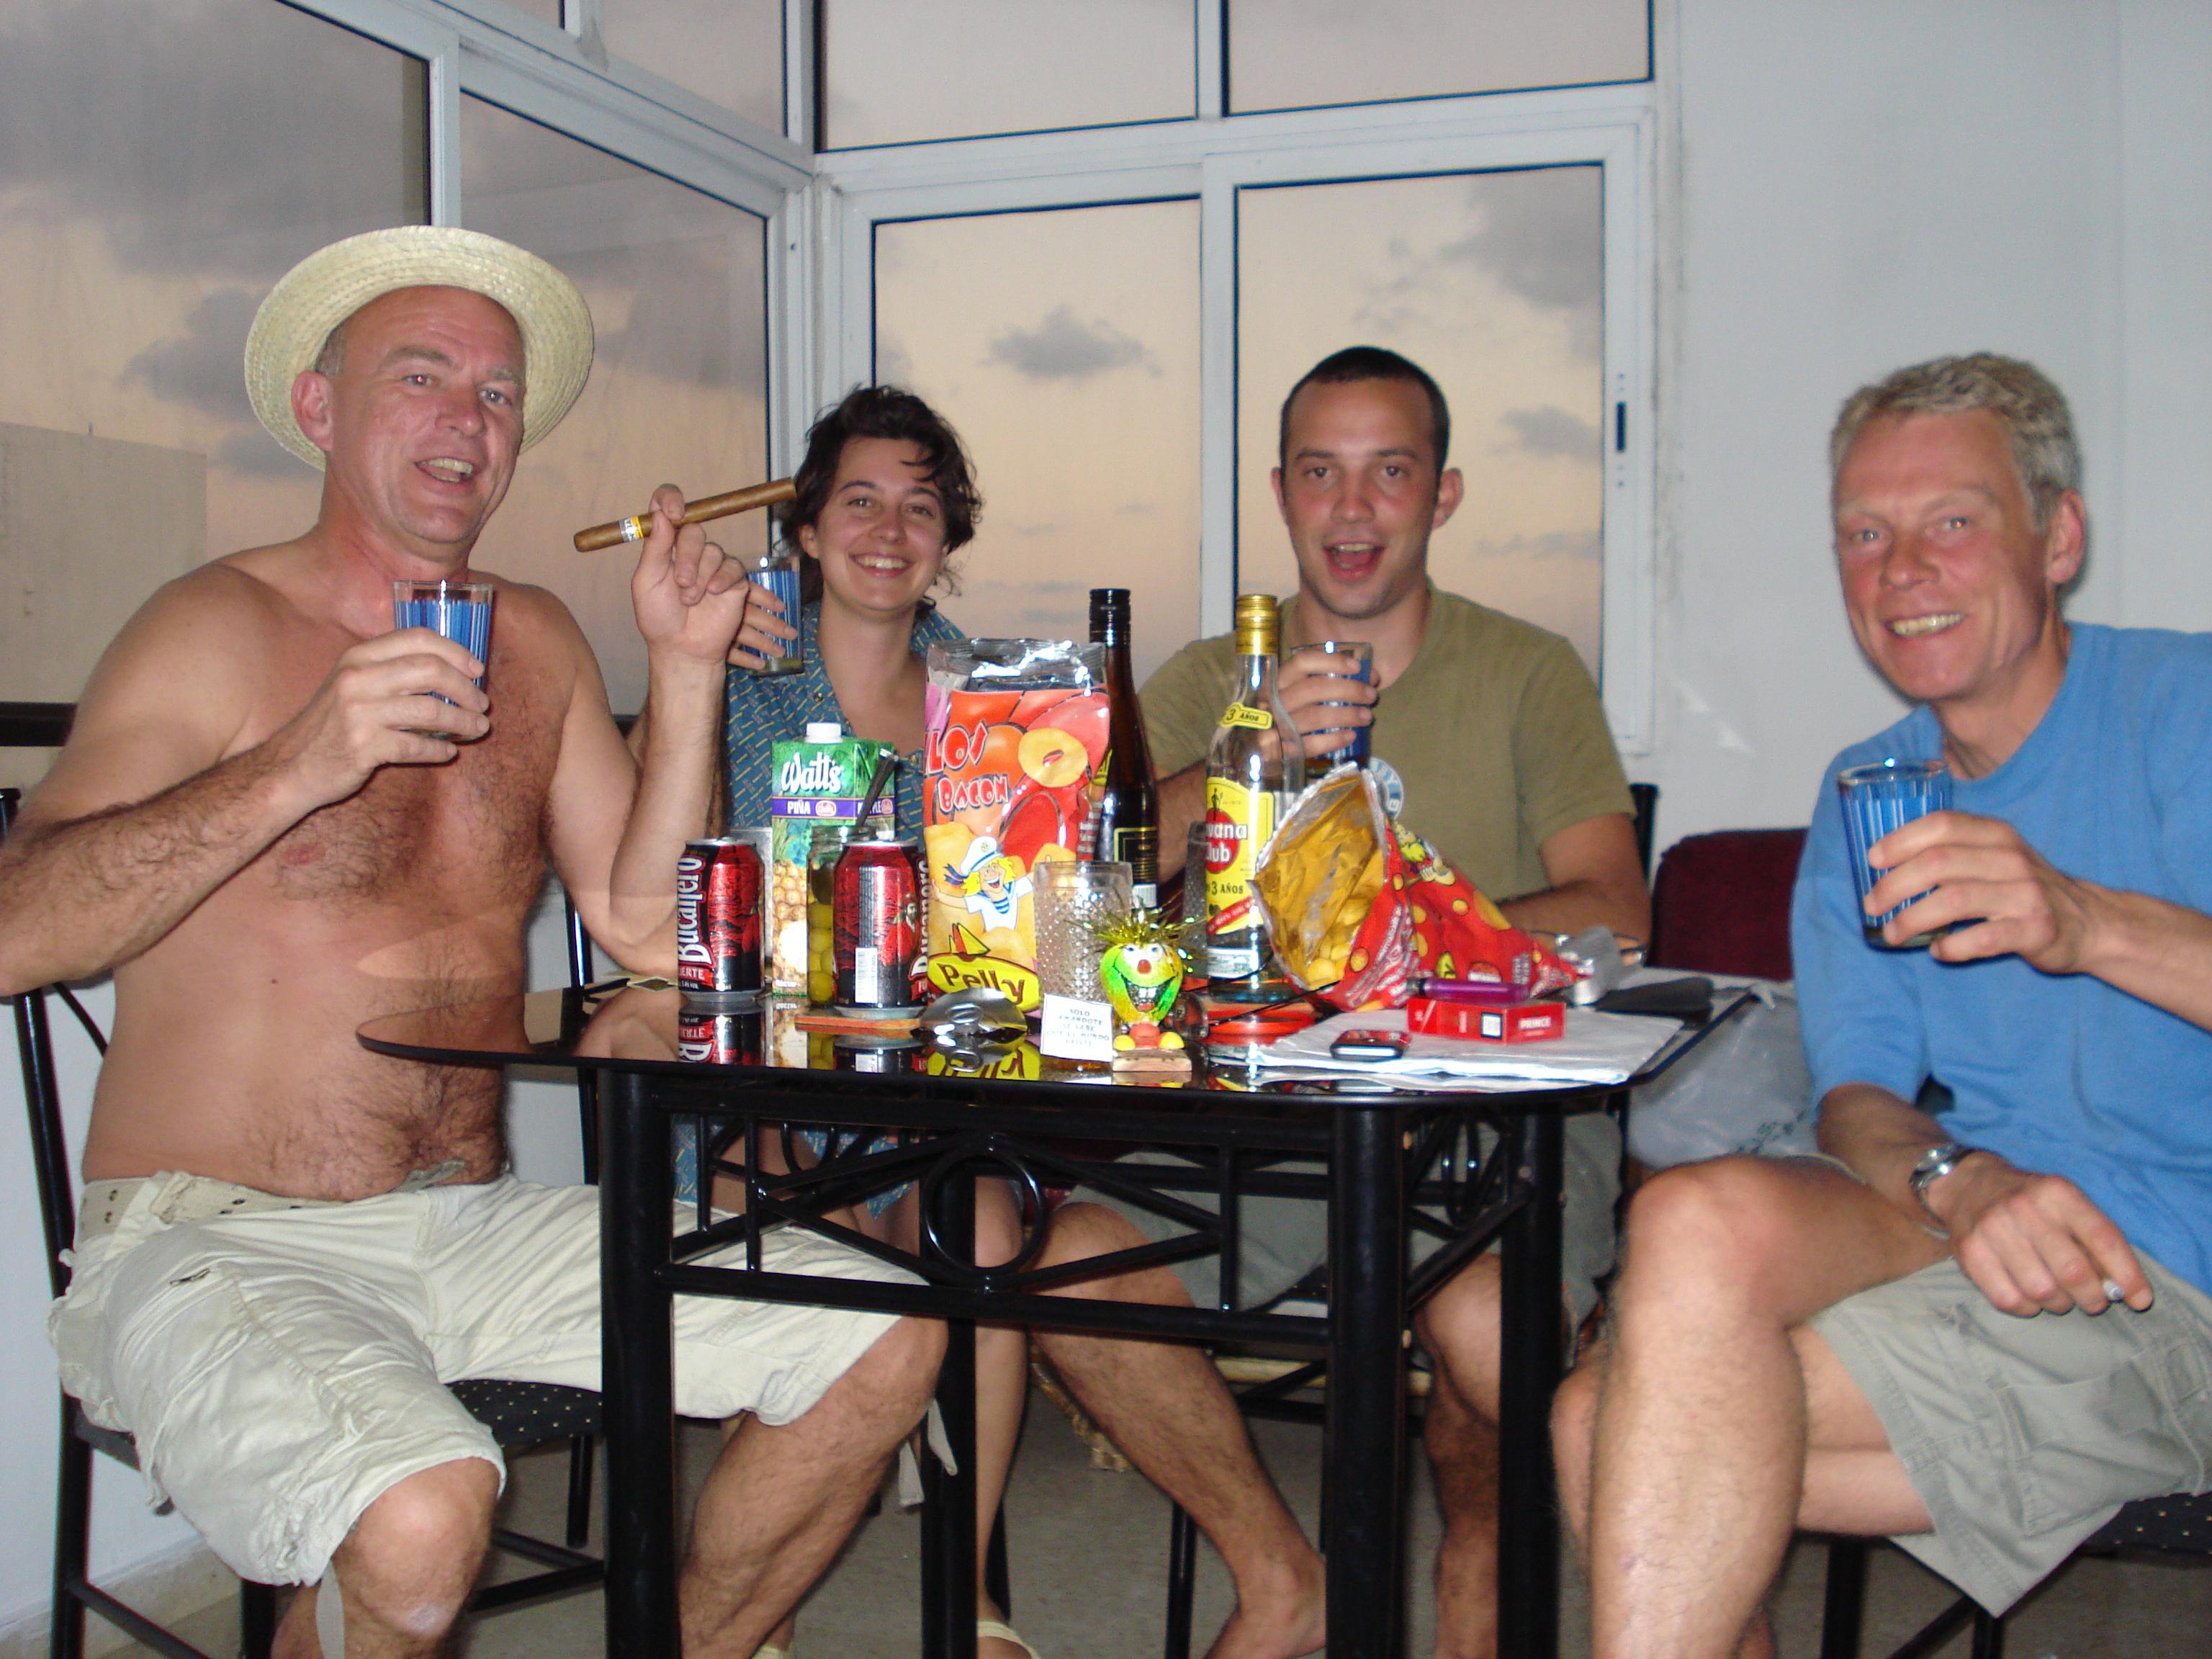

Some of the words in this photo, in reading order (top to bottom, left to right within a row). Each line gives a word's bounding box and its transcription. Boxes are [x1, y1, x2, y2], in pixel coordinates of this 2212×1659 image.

[1226, 709, 1236, 720] 3
[781, 752, 842, 793] Watt's
[938, 775, 1009, 812] BACON
[787, 799, 811, 815] PIÑA
[1206, 823, 1248, 840] vana
[1211, 881, 1218, 895] 3
[1220, 883, 1244, 894] AÑOS
[937, 963, 1025, 1004] Pelly
[1519, 1015, 1552, 1030] PRINCE
